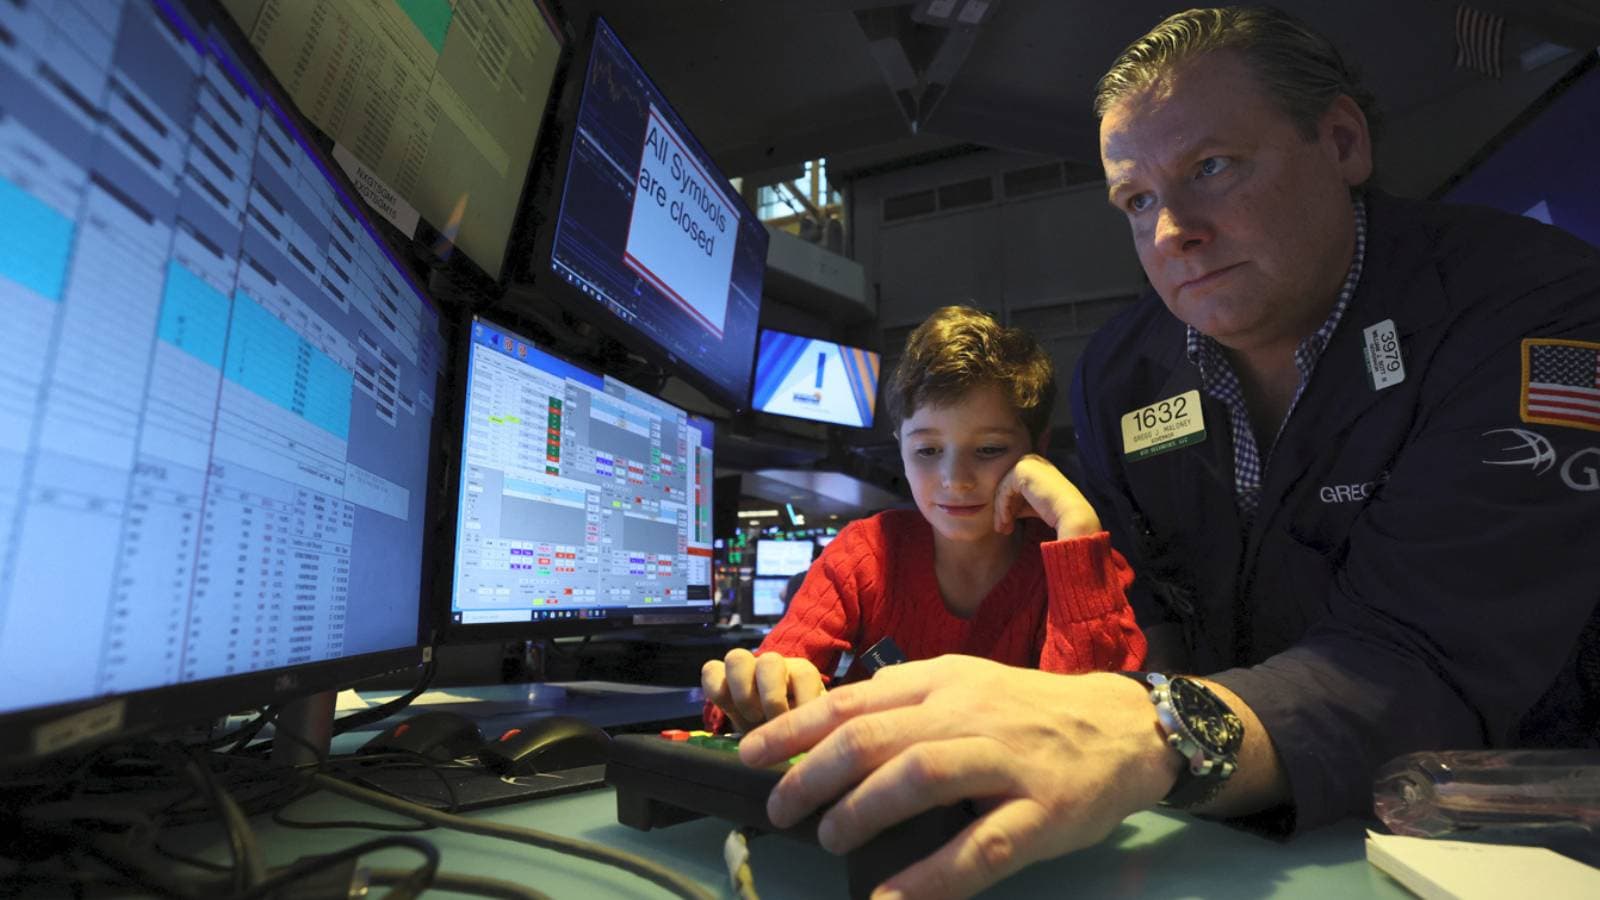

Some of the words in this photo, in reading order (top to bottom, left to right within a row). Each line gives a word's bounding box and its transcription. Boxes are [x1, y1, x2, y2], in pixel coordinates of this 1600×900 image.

[645, 126, 669, 165] All
[670, 153, 726, 233] Symbols
[639, 168, 667, 208] are
[670, 200, 715, 257] closed
[1381, 330, 1400, 372] 3979
[1132, 396, 1189, 432] 1632
